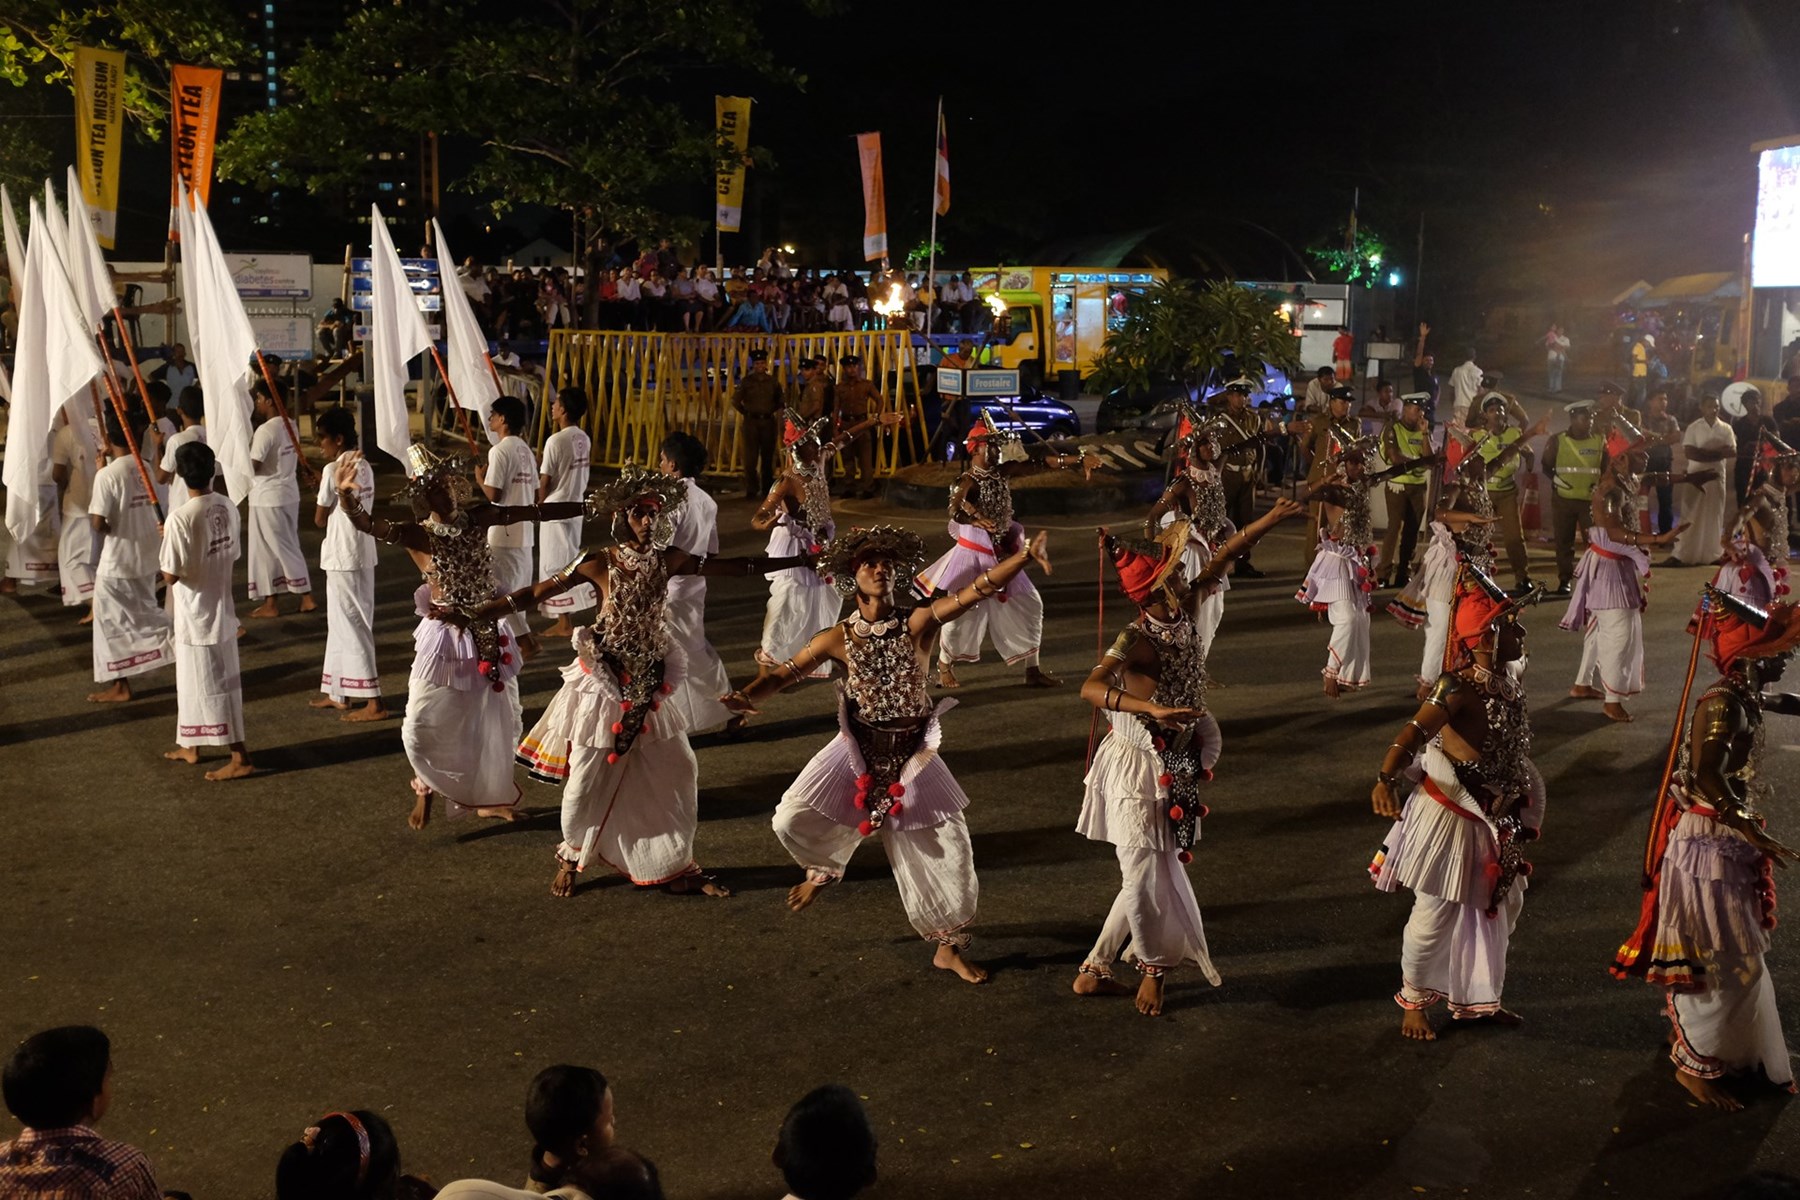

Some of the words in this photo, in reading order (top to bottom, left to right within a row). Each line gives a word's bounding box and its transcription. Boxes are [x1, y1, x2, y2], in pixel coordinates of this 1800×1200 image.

[94, 61, 108, 121] MUSEUM
[182, 85, 203, 117] TEA
[92, 123, 106, 146] TEA
[91, 148, 105, 197] YLON
[235, 272, 274, 284] diabetes
[244, 307, 316, 318] HANGING
[975, 378, 1011, 388] Frostaire
